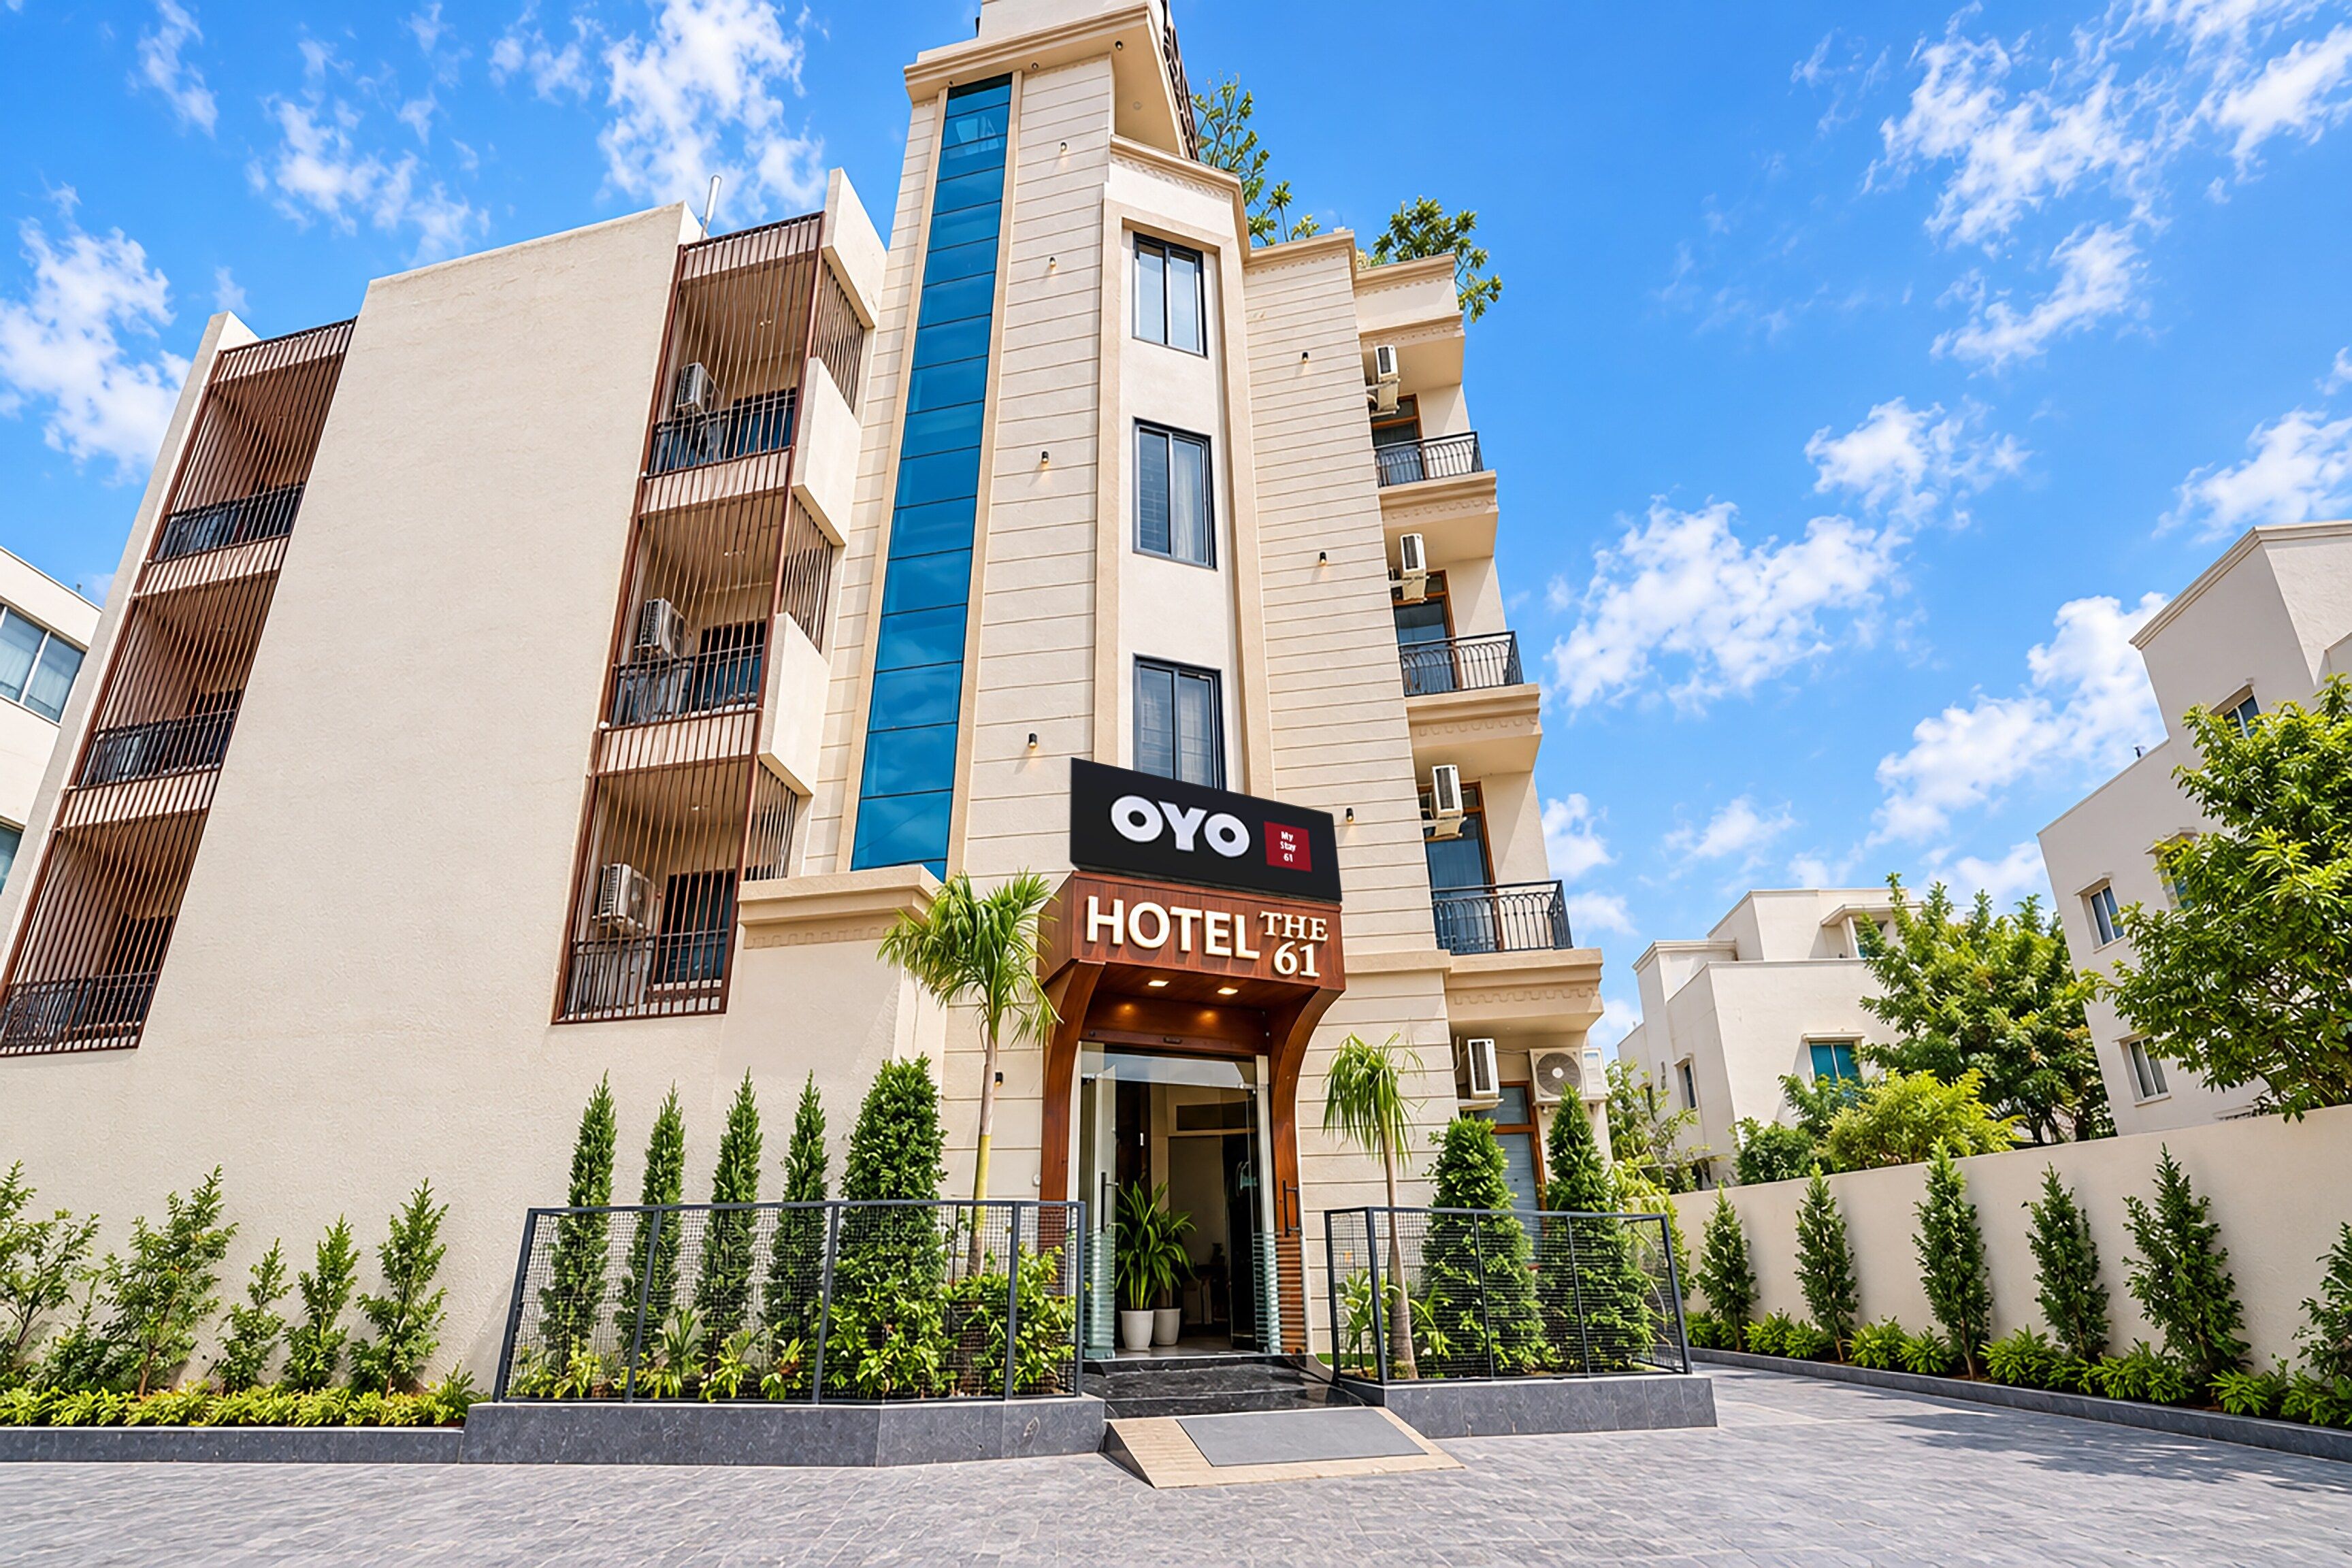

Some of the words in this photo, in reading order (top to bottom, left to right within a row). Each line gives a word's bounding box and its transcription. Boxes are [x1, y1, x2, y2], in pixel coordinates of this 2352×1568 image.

[1111, 795, 1250, 858] OYO
[1284, 853, 1293, 862] 61
[1087, 896, 1260, 960] HOTEL
[1260, 911, 1328, 941] THE
[1274, 941, 1320, 977] 61
